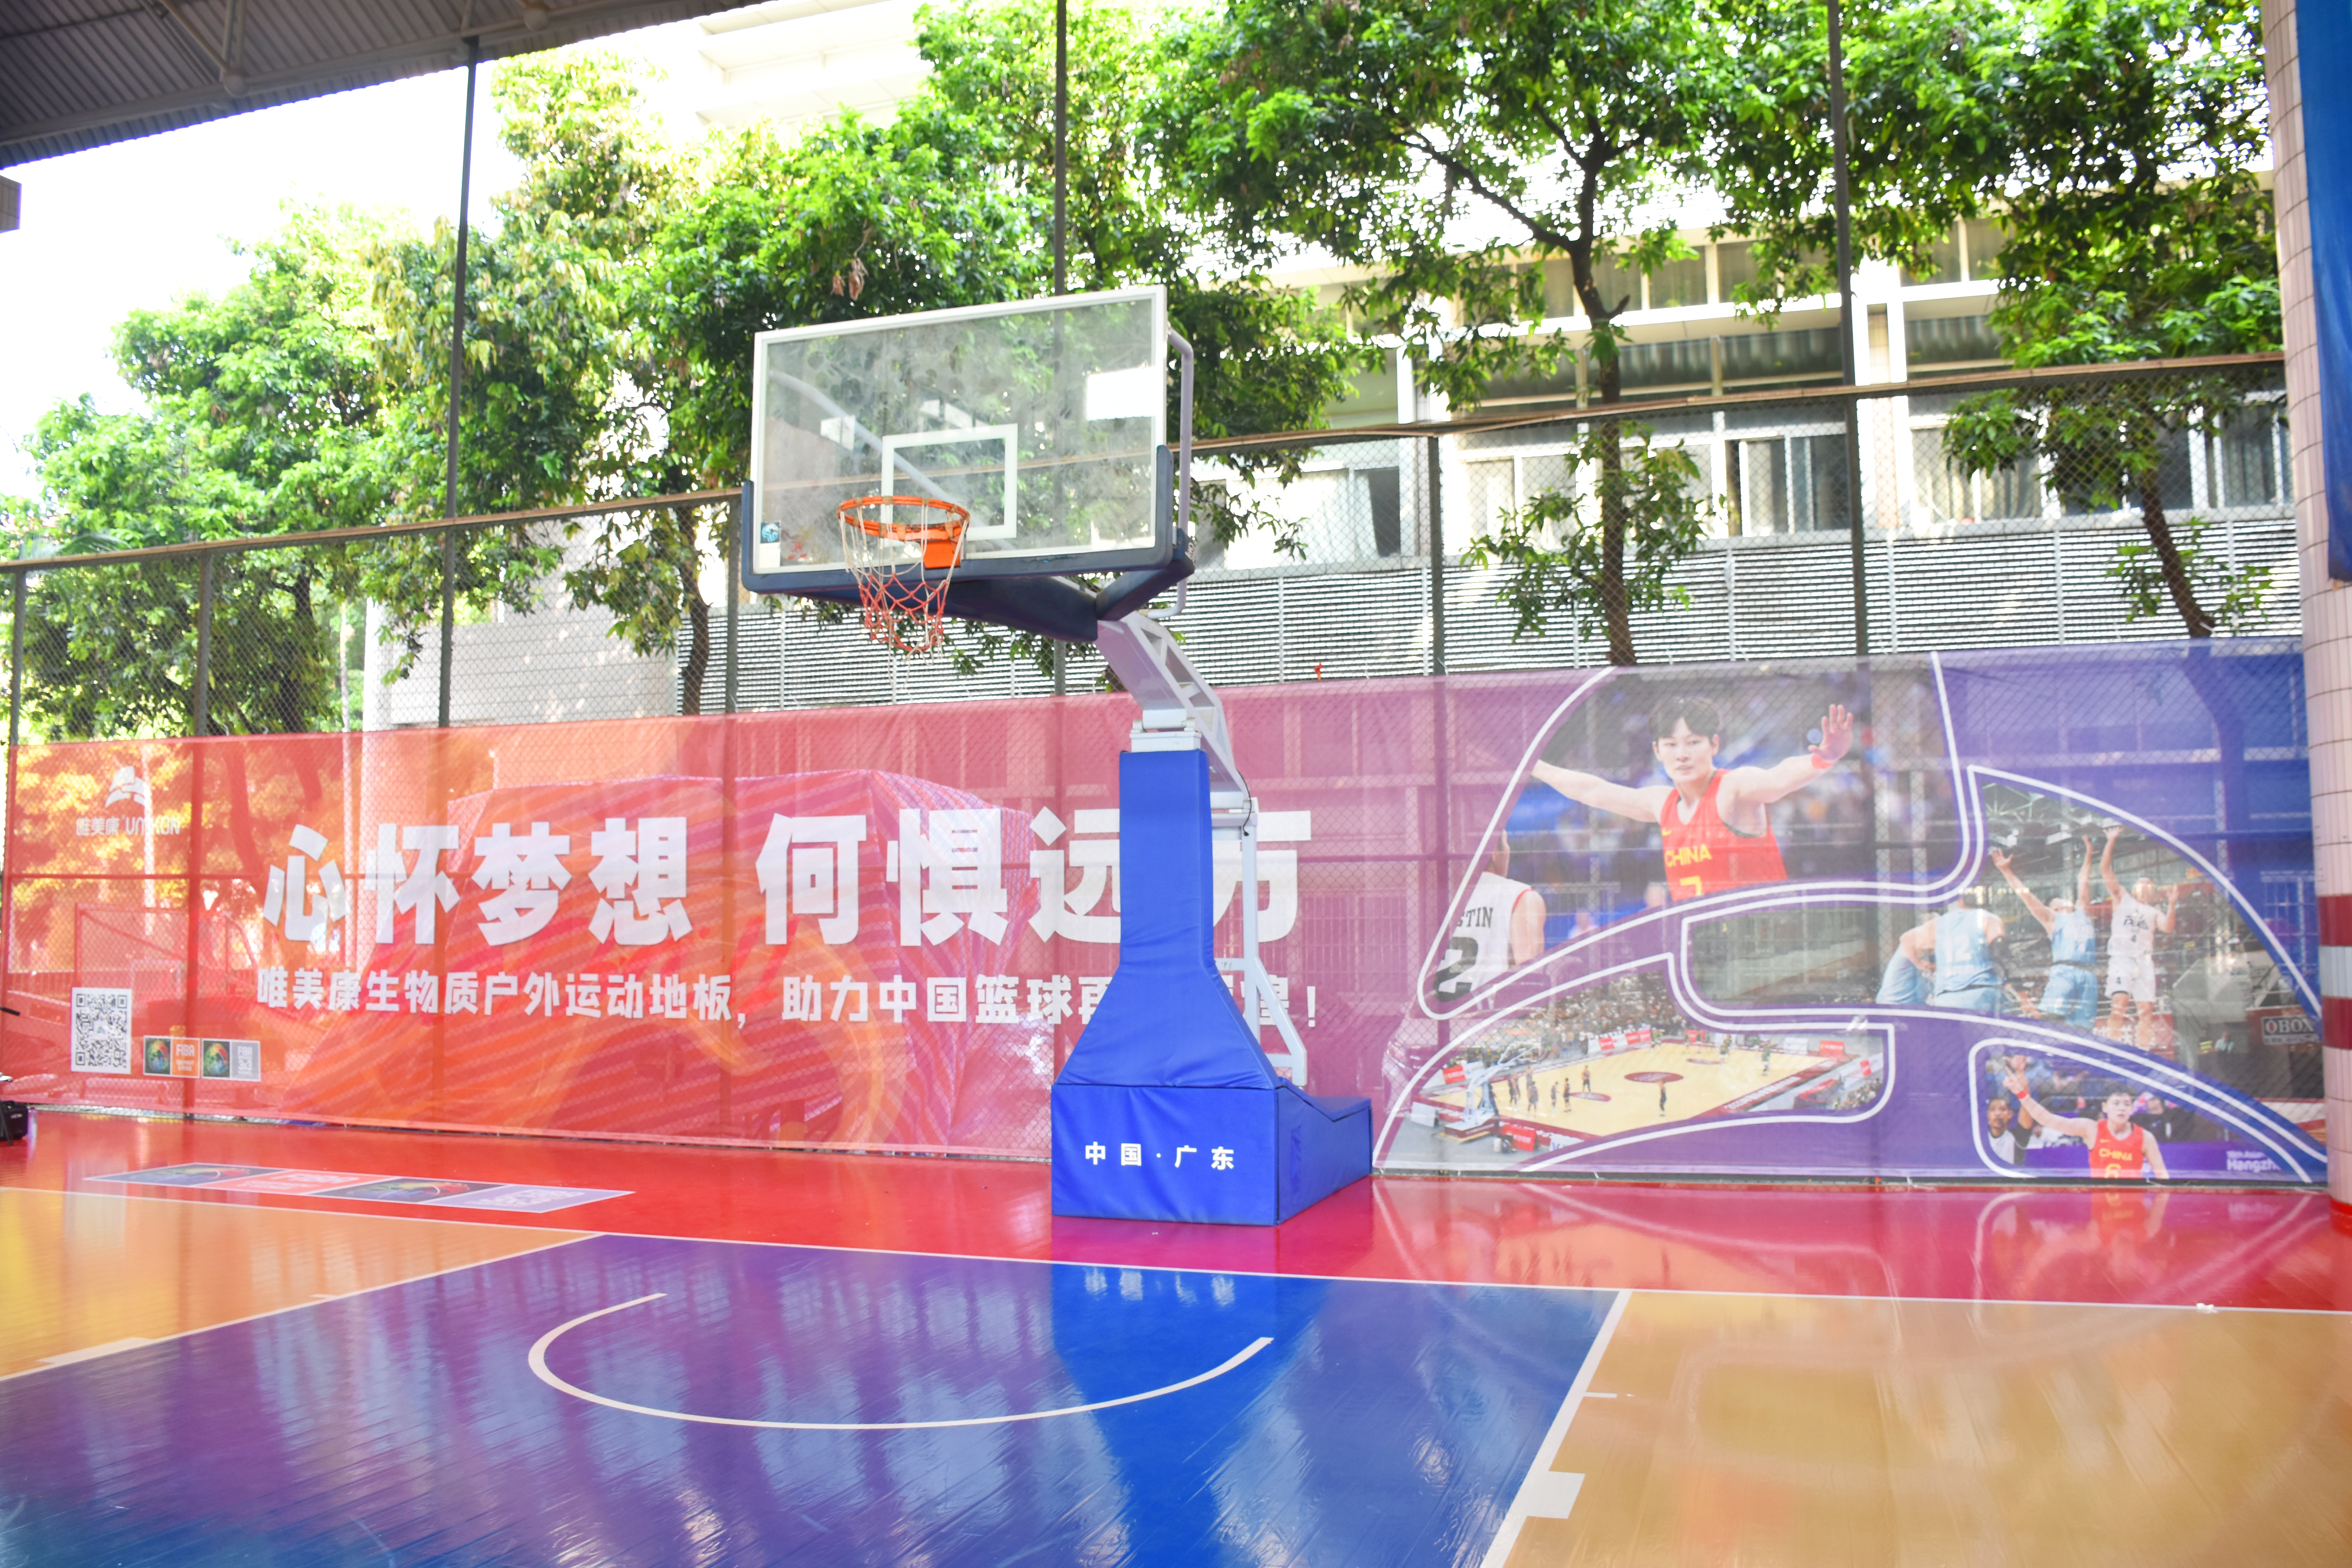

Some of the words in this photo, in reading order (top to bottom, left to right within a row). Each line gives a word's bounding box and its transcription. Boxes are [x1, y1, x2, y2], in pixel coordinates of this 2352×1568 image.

[76, 817, 120, 836] 唯美康
[125, 816, 181, 835] UNKON
[1665, 843, 1712, 867] CHINA
[263, 816, 693, 946] 心怀梦想
[1945, 934, 1973, 963] 12
[1433, 936, 1478, 1002] 2
[176, 1043, 195, 1056] FIBA
[1085, 1141, 1234, 1171] 中国·广东
[2099, 1148, 2132, 1161] CHINA
